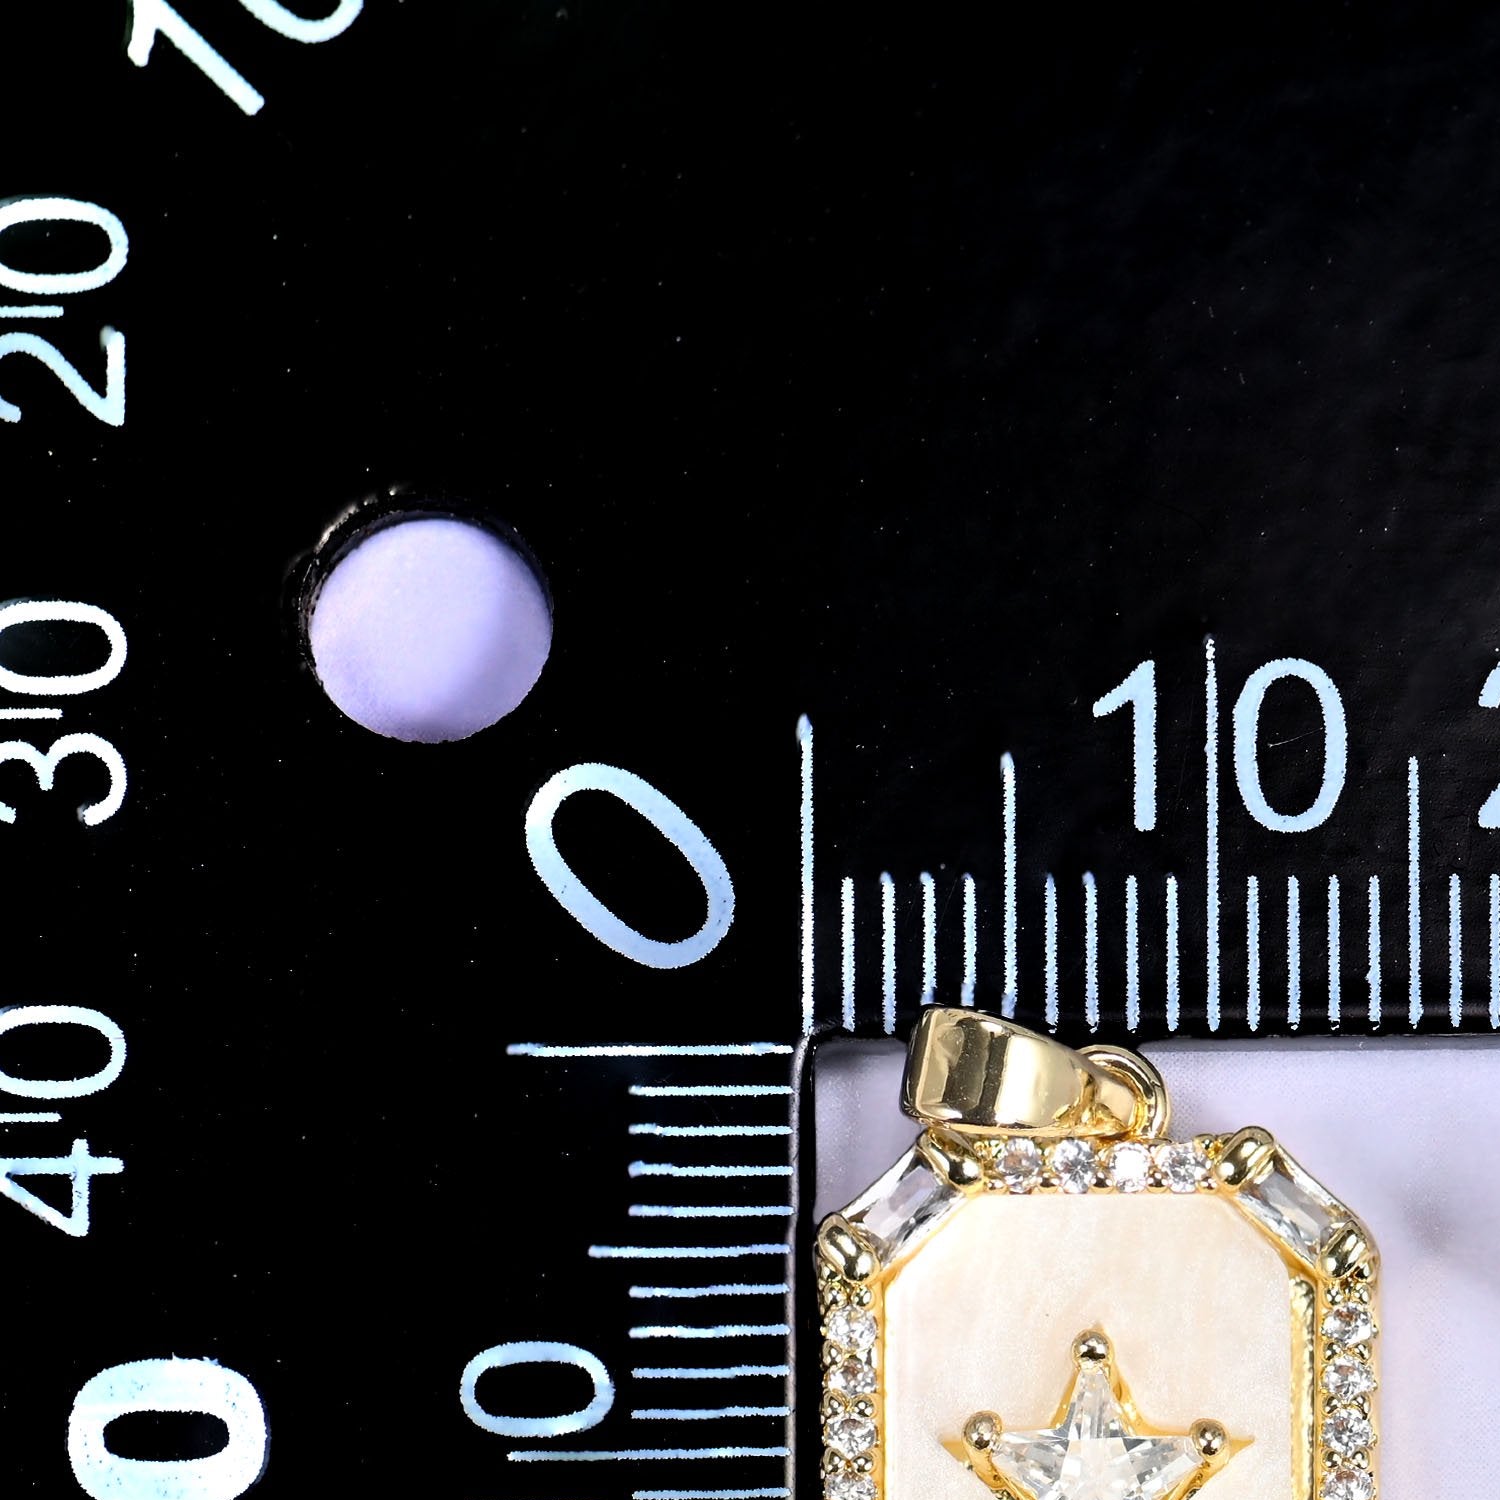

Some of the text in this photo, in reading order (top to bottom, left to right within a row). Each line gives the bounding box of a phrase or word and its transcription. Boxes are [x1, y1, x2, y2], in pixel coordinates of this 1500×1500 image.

[127, 0, 364, 116] 1
[0, 196, 129, 428] 20
[0, 599, 127, 827] 30
[1092, 657, 1349, 834] 10
[523, 761, 736, 970] 0
[0, 1004, 127, 1238] 40
